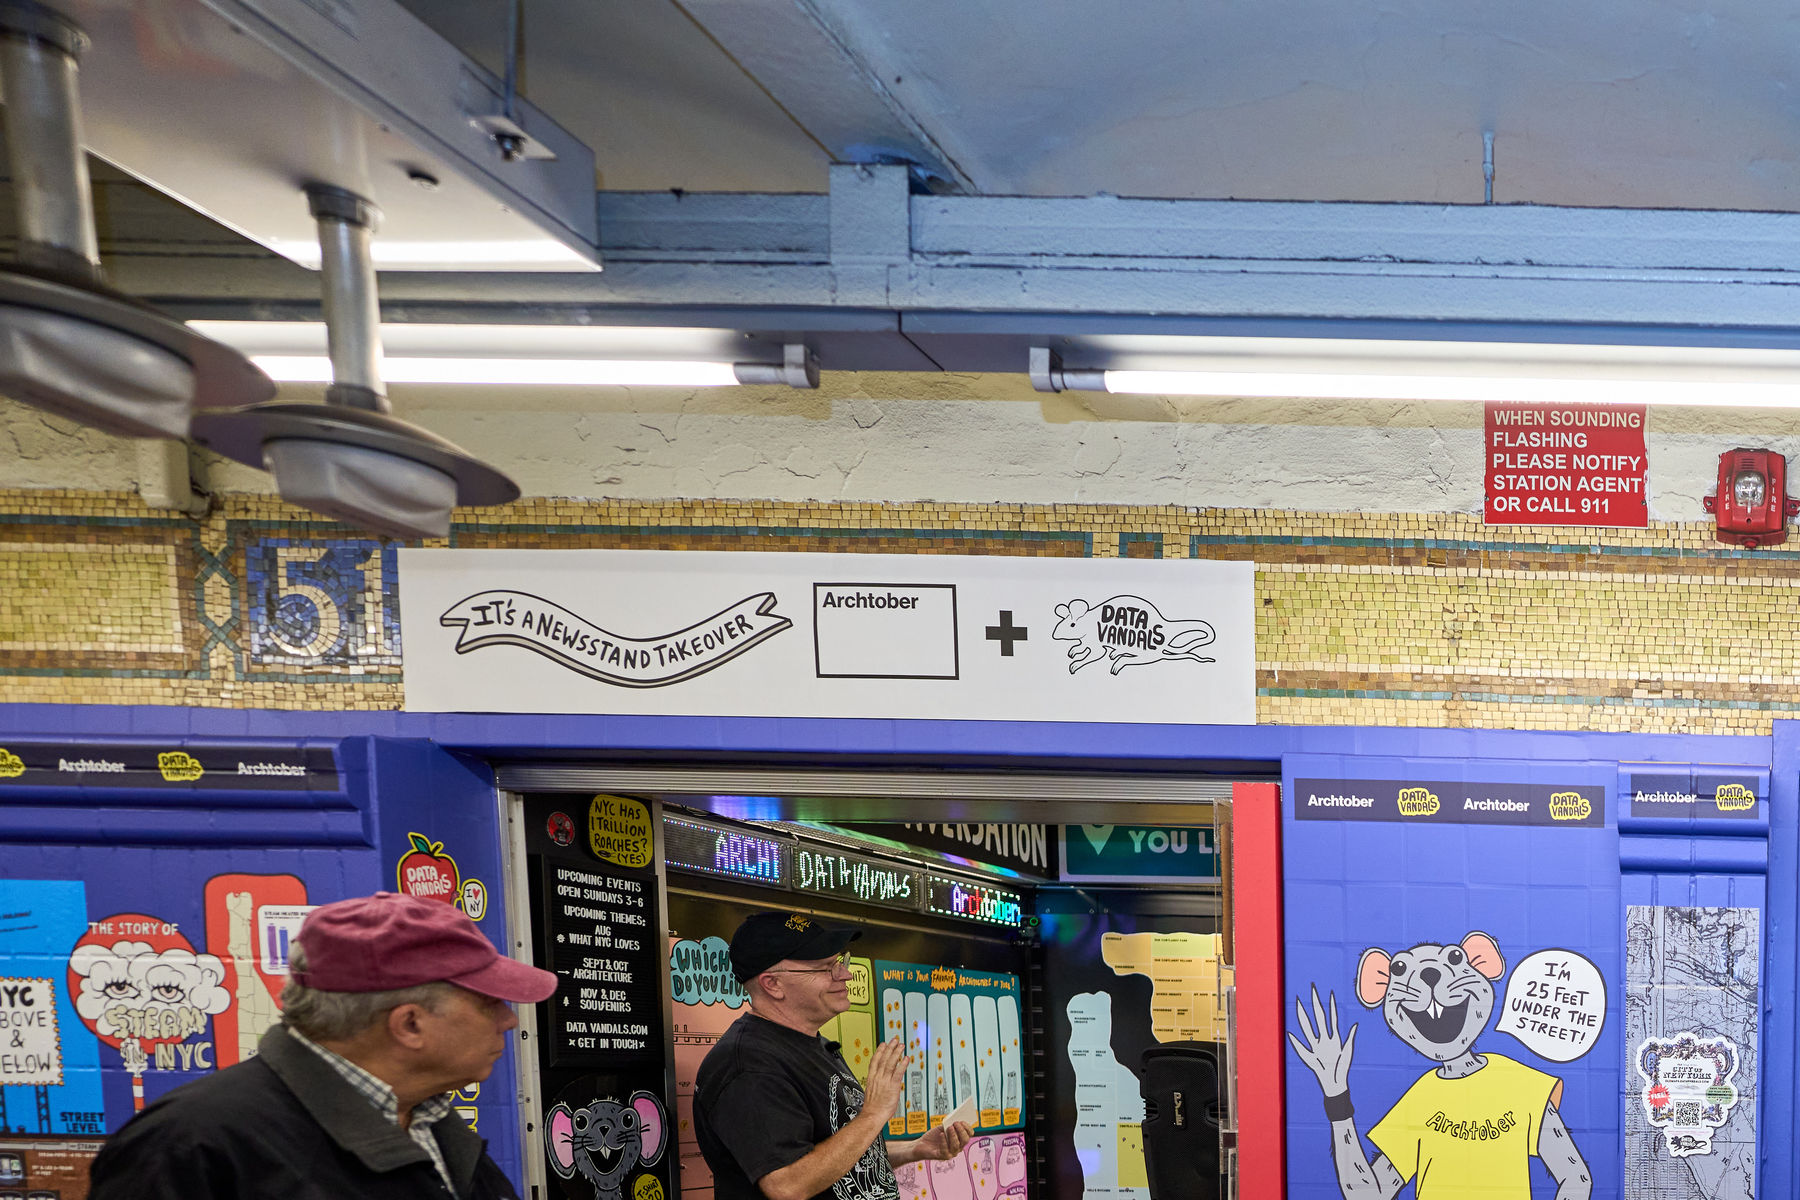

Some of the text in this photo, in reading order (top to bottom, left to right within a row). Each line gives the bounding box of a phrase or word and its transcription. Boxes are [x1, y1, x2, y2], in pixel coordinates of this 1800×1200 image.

[1494, 410, 1641, 428] WHEN SOUNDING
[1493, 432, 1588, 448] FLASHING
[1493, 454, 1641, 472] PLEASE NOTIFY
[1493, 475, 1642, 493] STATION AGENT
[1493, 496, 1610, 514] OR CALL 911
[266, 545, 397, 658] 51
[822, 591, 919, 611] Archtober
[1101, 603, 1149, 630] DATA
[474, 598, 753, 671] IT'S A NEWSSTAND TAKEOVER
[1096, 621, 1165, 651] VANDALS
[58, 758, 306, 777] Archtober Archtober
[1307, 793, 1374, 809] Archtober
[1400, 789, 1428, 802] DATA
[1463, 798, 1530, 812] Archtober
[1551, 794, 1578, 807] DATA
[594, 799, 641, 820] NYC HAS
[1400, 797, 1438, 816] VANDALS
[1550, 801, 1589, 820] VANDALS
[596, 816, 646, 836] TRILLION
[594, 833, 648, 852] ROACHES?
[1129, 830, 1195, 853] YOU
[616, 852, 646, 865] (YES)
[406, 866, 439, 882] DATA
[557, 868, 642, 893] UPCOMING EVENTS
[406, 874, 452, 897] VANDALS
[470, 900, 481, 912] NY
[557, 885, 644, 908] OPEN SUNDAYS 3-6
[564, 905, 646, 927] UPCOMING THEMES:
[88, 922, 179, 936] THE STORY OF
[595, 925, 611, 937] AUG
[569, 933, 640, 951] WHAT NYC LOVES
[573, 968, 633, 983] ARCHITEKTURE
[1544, 961, 1572, 982] I'M
[580, 988, 597, 999] NOV
[609, 990, 626, 1001] DEC
[1526, 981, 1590, 1008] 25 FEET
[580, 999, 631, 1013] SOUVENIRS
[1511, 998, 1597, 1029] UNDER THE
[105, 1004, 207, 1040] STEAM
[566, 1021, 648, 1036] DATA VANDALS.COM
[1516, 1018, 1586, 1046] STREET!
[578, 1038, 638, 1050] GET IN TOUCH
[155, 1041, 213, 1071] NYC
[60, 1111, 105, 1123] STREET
[1425, 1111, 1517, 1141] Archtober
[65, 1122, 103, 1134] LEVEL
[637, 1178, 659, 1200] T-SHIRT
